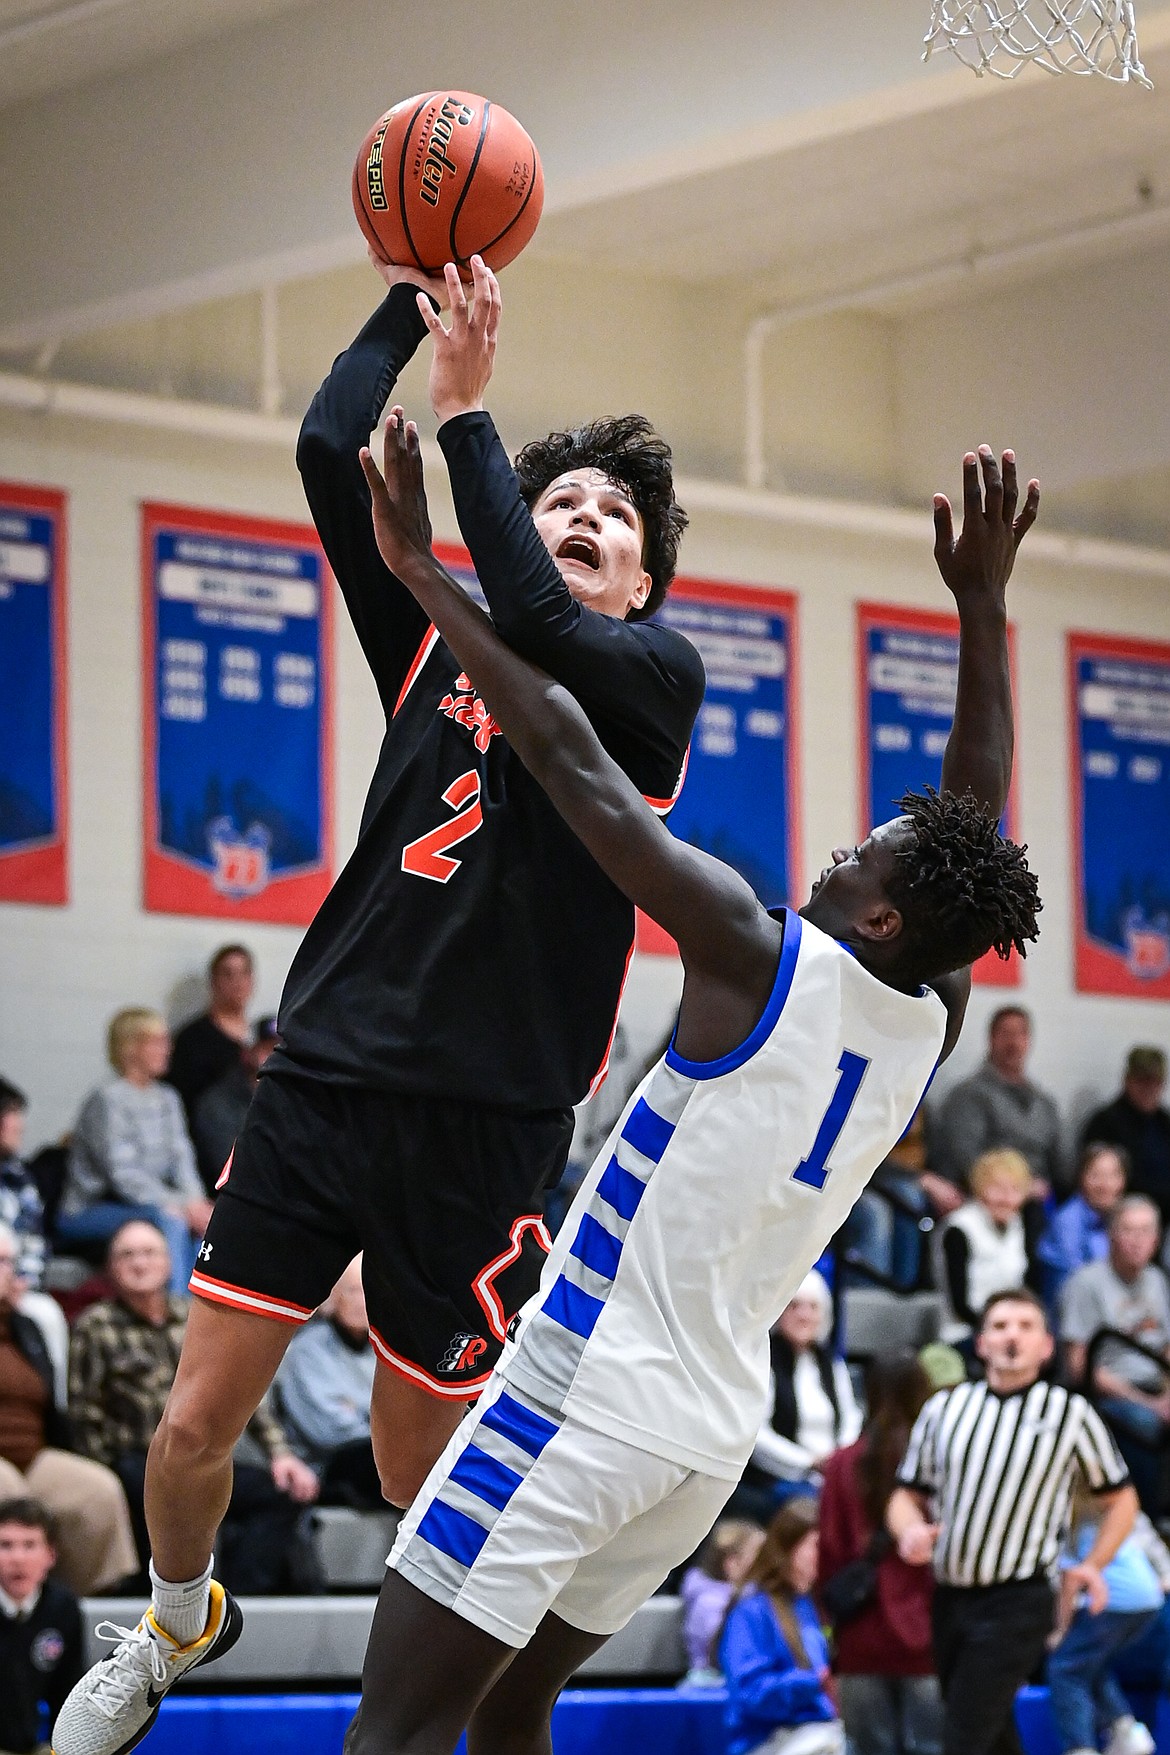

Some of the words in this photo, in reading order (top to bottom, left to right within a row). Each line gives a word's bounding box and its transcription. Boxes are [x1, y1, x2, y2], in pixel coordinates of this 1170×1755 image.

[413, 107, 436, 178] PERFECTION
[420, 97, 475, 207] Baden
[515, 162, 530, 199] GAME
[368, 165, 387, 211] PRO
[401, 769, 484, 884] 2
[789, 1047, 872, 1193] 1
